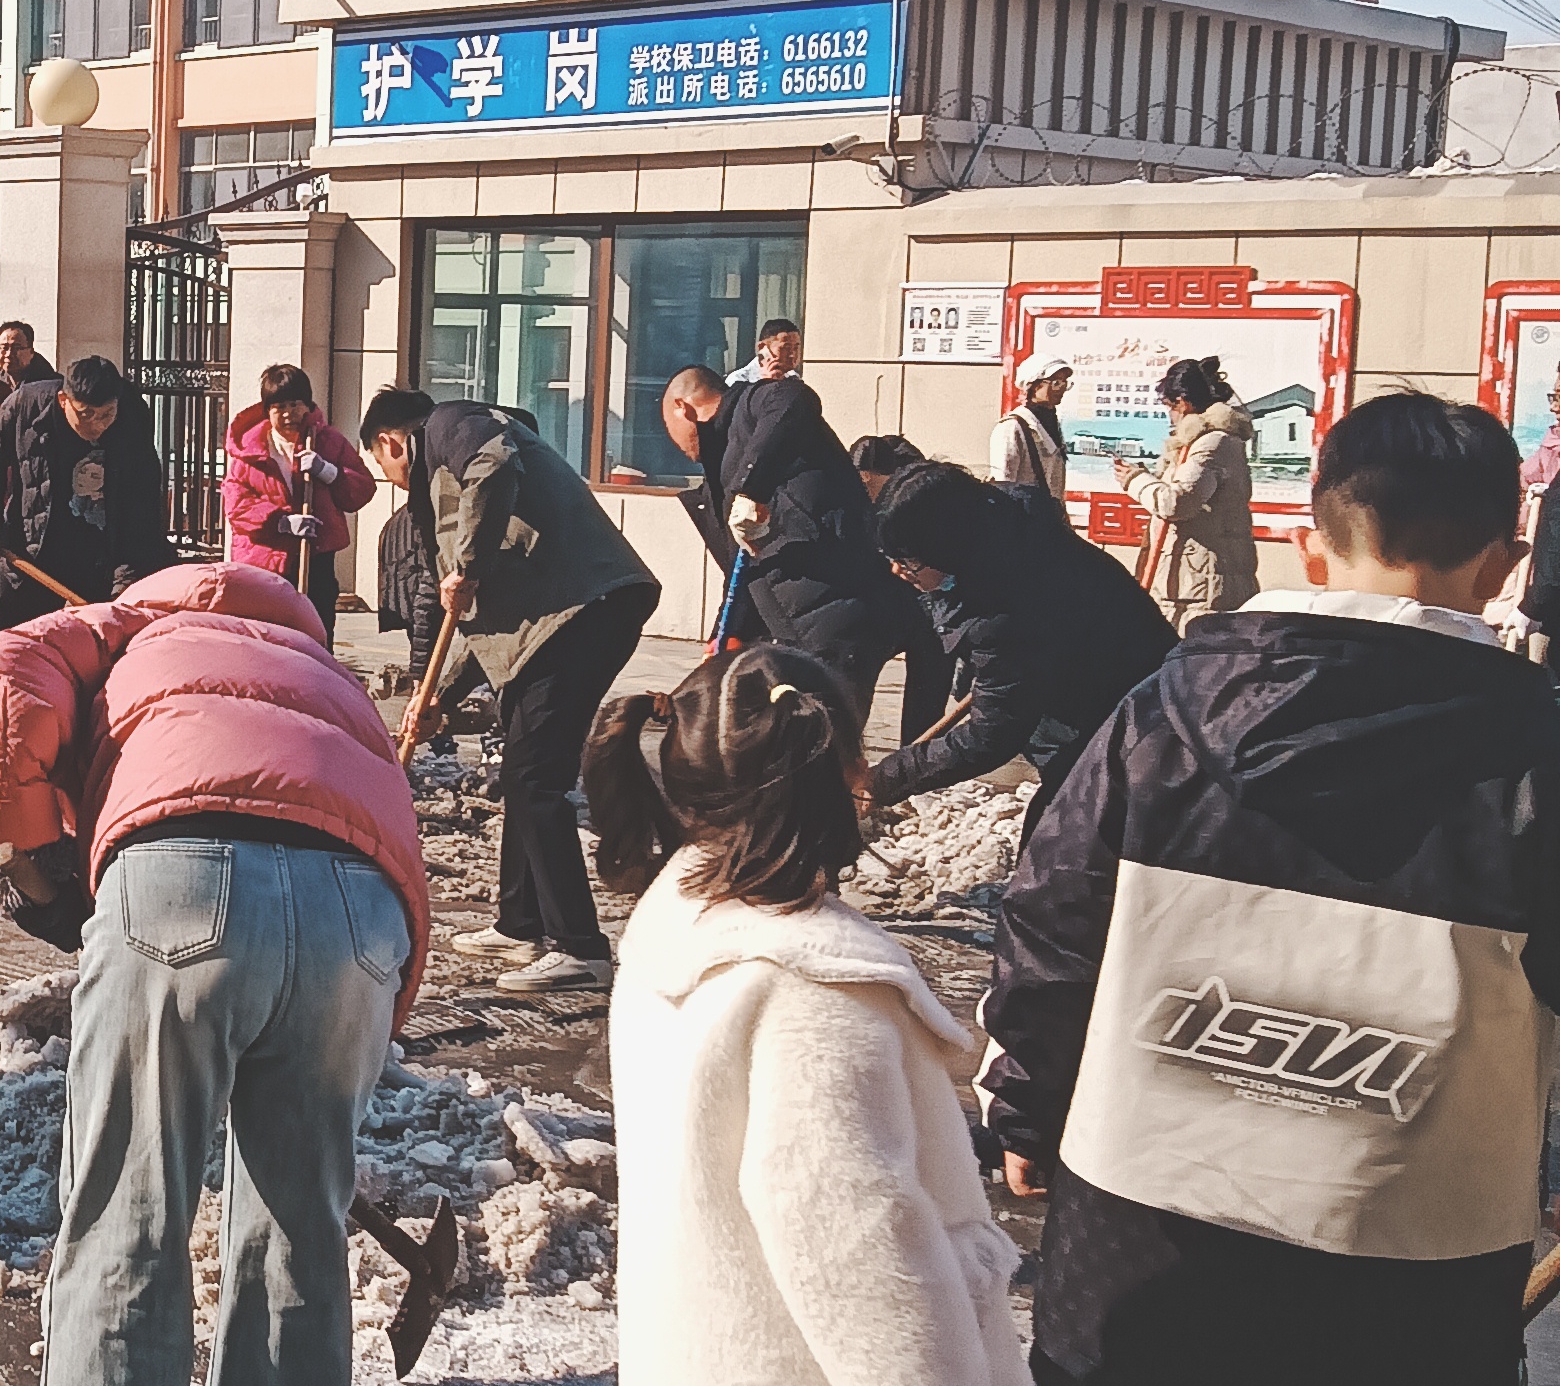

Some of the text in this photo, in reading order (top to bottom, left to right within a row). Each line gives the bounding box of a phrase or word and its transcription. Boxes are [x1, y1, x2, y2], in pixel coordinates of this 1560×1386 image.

[360, 27, 600, 122] 护学岗
[629, 29, 869, 75] 学校保卫电话： 6166132
[627, 62, 866, 106] 派出所电话： 6565610
